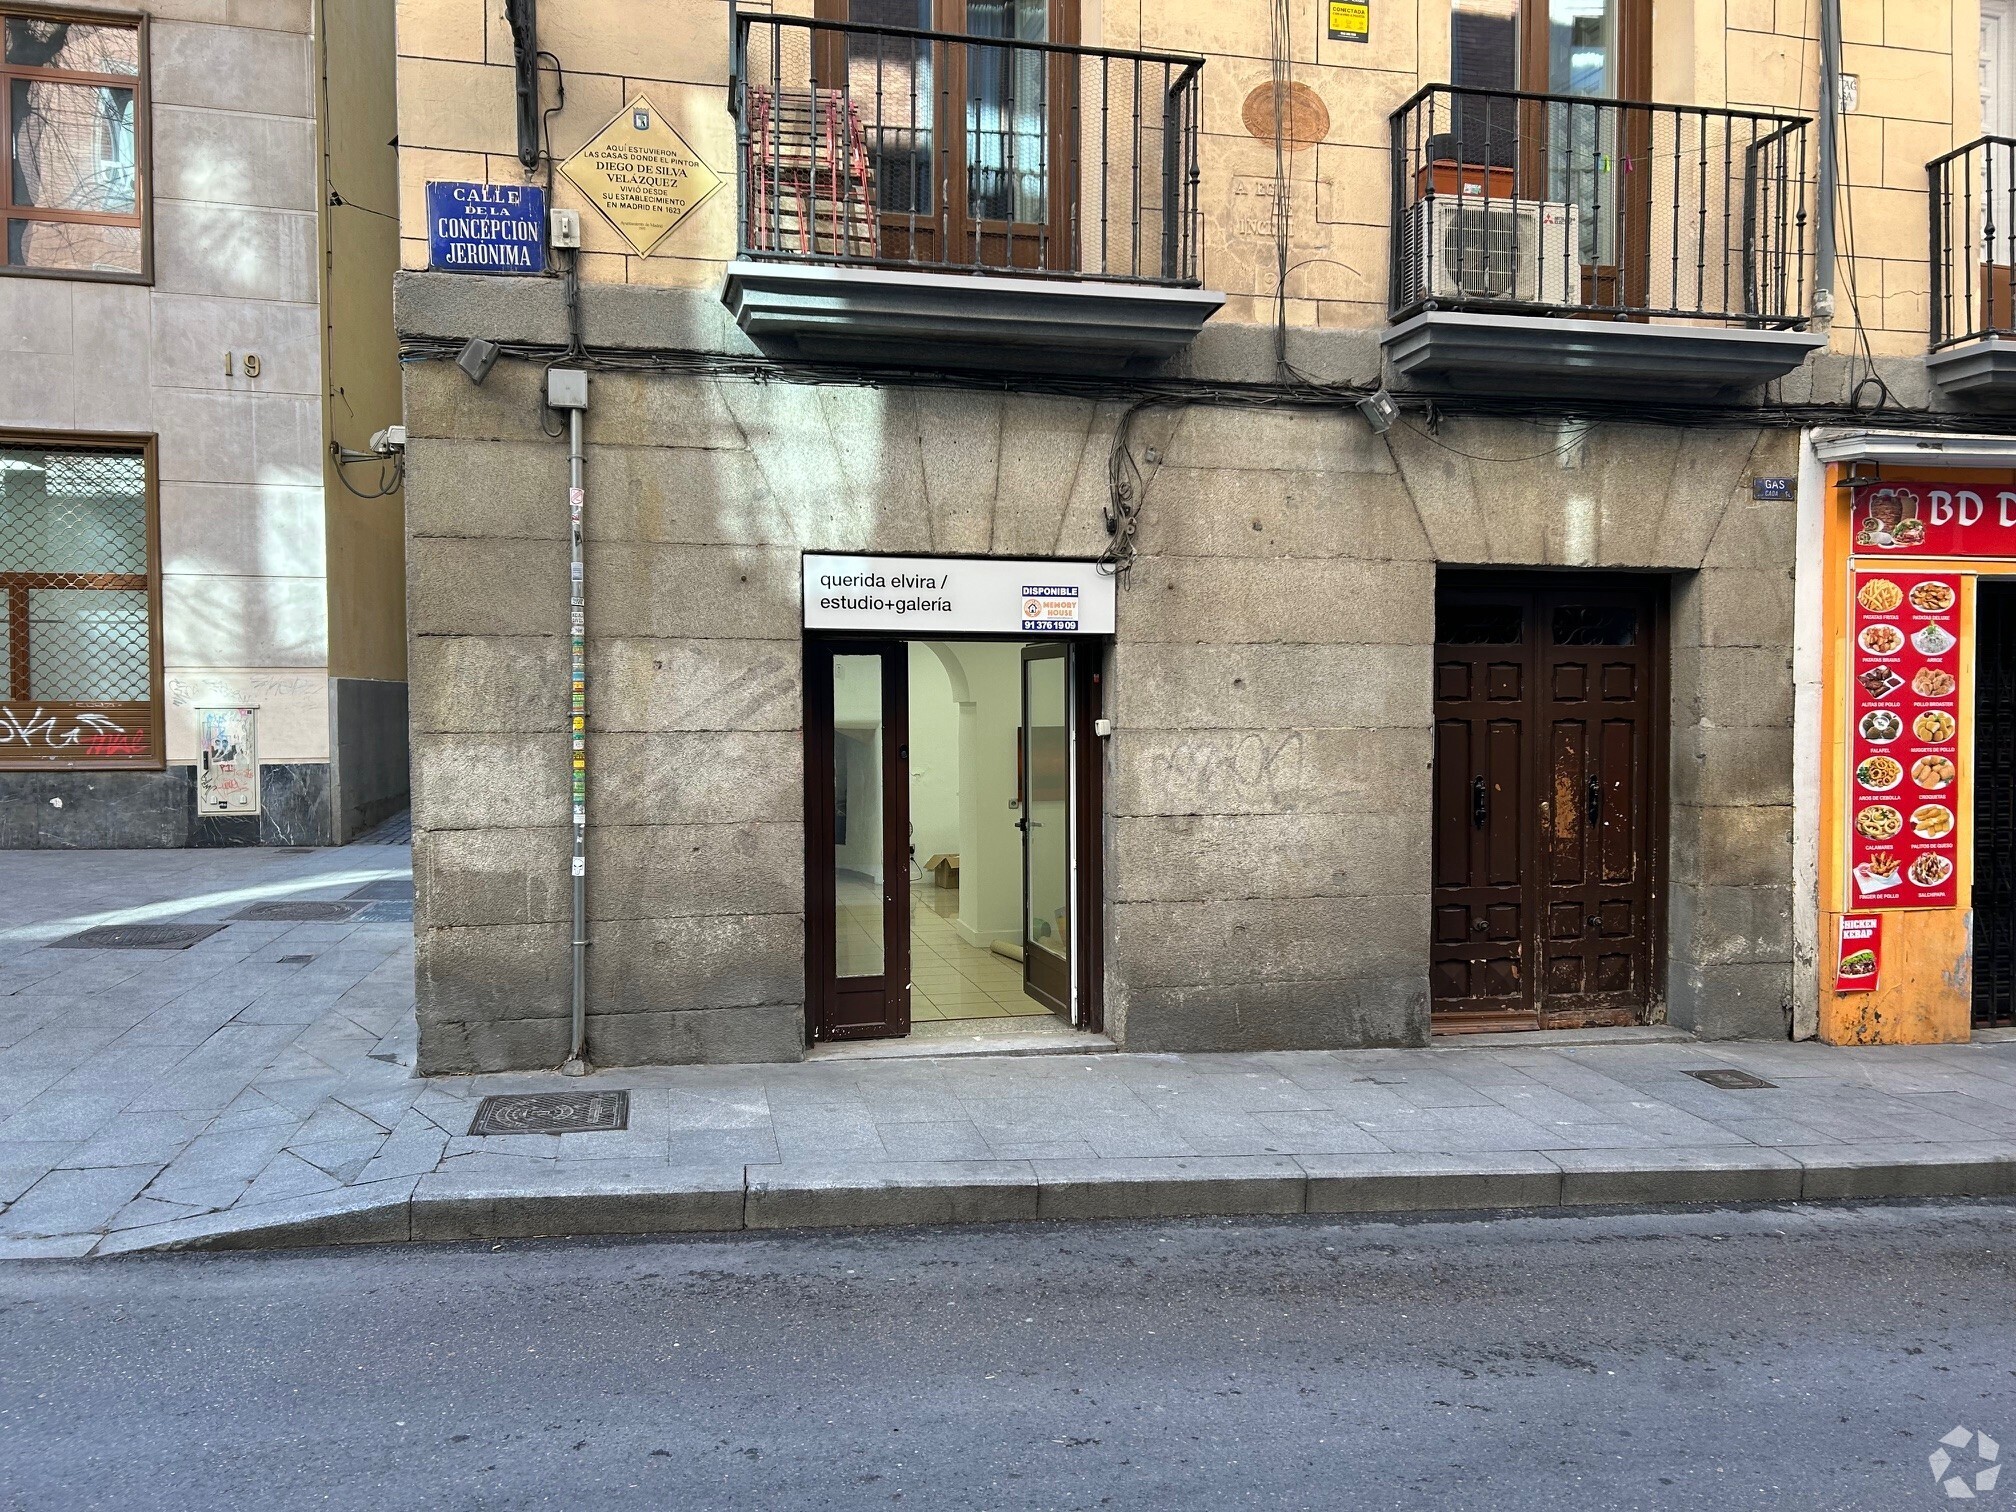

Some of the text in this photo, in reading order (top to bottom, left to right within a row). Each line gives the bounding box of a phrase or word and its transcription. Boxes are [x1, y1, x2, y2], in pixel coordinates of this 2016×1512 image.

[606, 144, 677, 157] AQUÍ ESTUVIERON
[630, 154, 658, 162] DONDE
[670, 158, 699, 167] PINTOR
[596, 162, 688, 178] DIEGO DE SILVA
[607, 174, 678, 188] VELÁZQUEZ
[454, 188, 520, 204] CALLE
[620, 185, 668, 196] VIVIÓ DESDE
[616, 193, 685, 206] ESTABLECIMIENTO
[465, 206, 510, 216] DE LA
[438, 217, 538, 241] CONCEPCIÓN
[446, 240, 531, 266] JERÓNIMA
[225, 351, 260, 378] 19
[1765, 480, 1785, 489] GAS
[1927, 490, 1983, 526] BD
[820, 573, 885, 589] querida
[891, 574, 936, 588] elvira
[1023, 587, 1077, 596] DISPONIBLE
[820, 595, 952, 614] estudio+galería
[1024, 621, 1076, 630] 91 376 19 09
[1843, 929, 1873, 939] KEBAP
